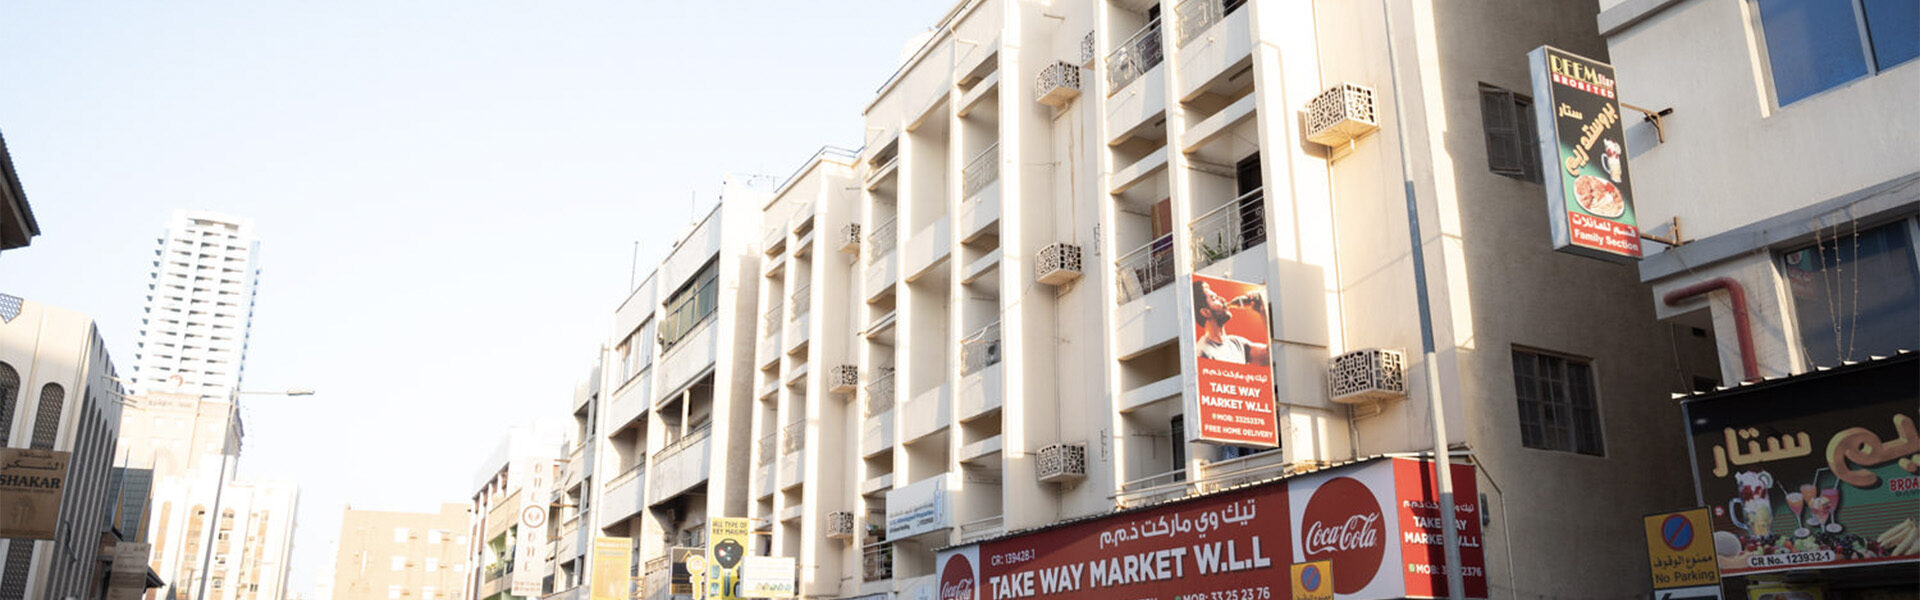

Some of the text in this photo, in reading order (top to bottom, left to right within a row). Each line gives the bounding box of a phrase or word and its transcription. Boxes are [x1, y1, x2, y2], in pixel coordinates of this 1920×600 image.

[1550, 54, 1599, 85] REEM
[1574, 228, 1639, 251] Family Section
[1209, 382, 1261, 398] TAKE WAY
[1201, 395, 1243, 410] MARKET
[1204, 424, 1274, 438] FREE HOME DELIVERY
[1713, 427, 1812, 478] ستار
[1889, 476, 1920, 492] BROA
[1222, 499, 1257, 527] تيك
[1141, 513, 1192, 538] ماركت
[1194, 511, 1219, 539] وي
[1413, 515, 1442, 529] TAKE
[1305, 512, 1380, 555] Coca-Cola
[1404, 531, 1444, 545] MARKE
[1751, 551, 1831, 566] CR No. 123932-1
[989, 536, 1272, 600] TAKE WAY MARKET W.L.L
[1655, 569, 1716, 583] No Parking
[1225, 589, 1238, 600] 25
[1241, 588, 1254, 600] 23
[1257, 586, 1271, 599] 76
